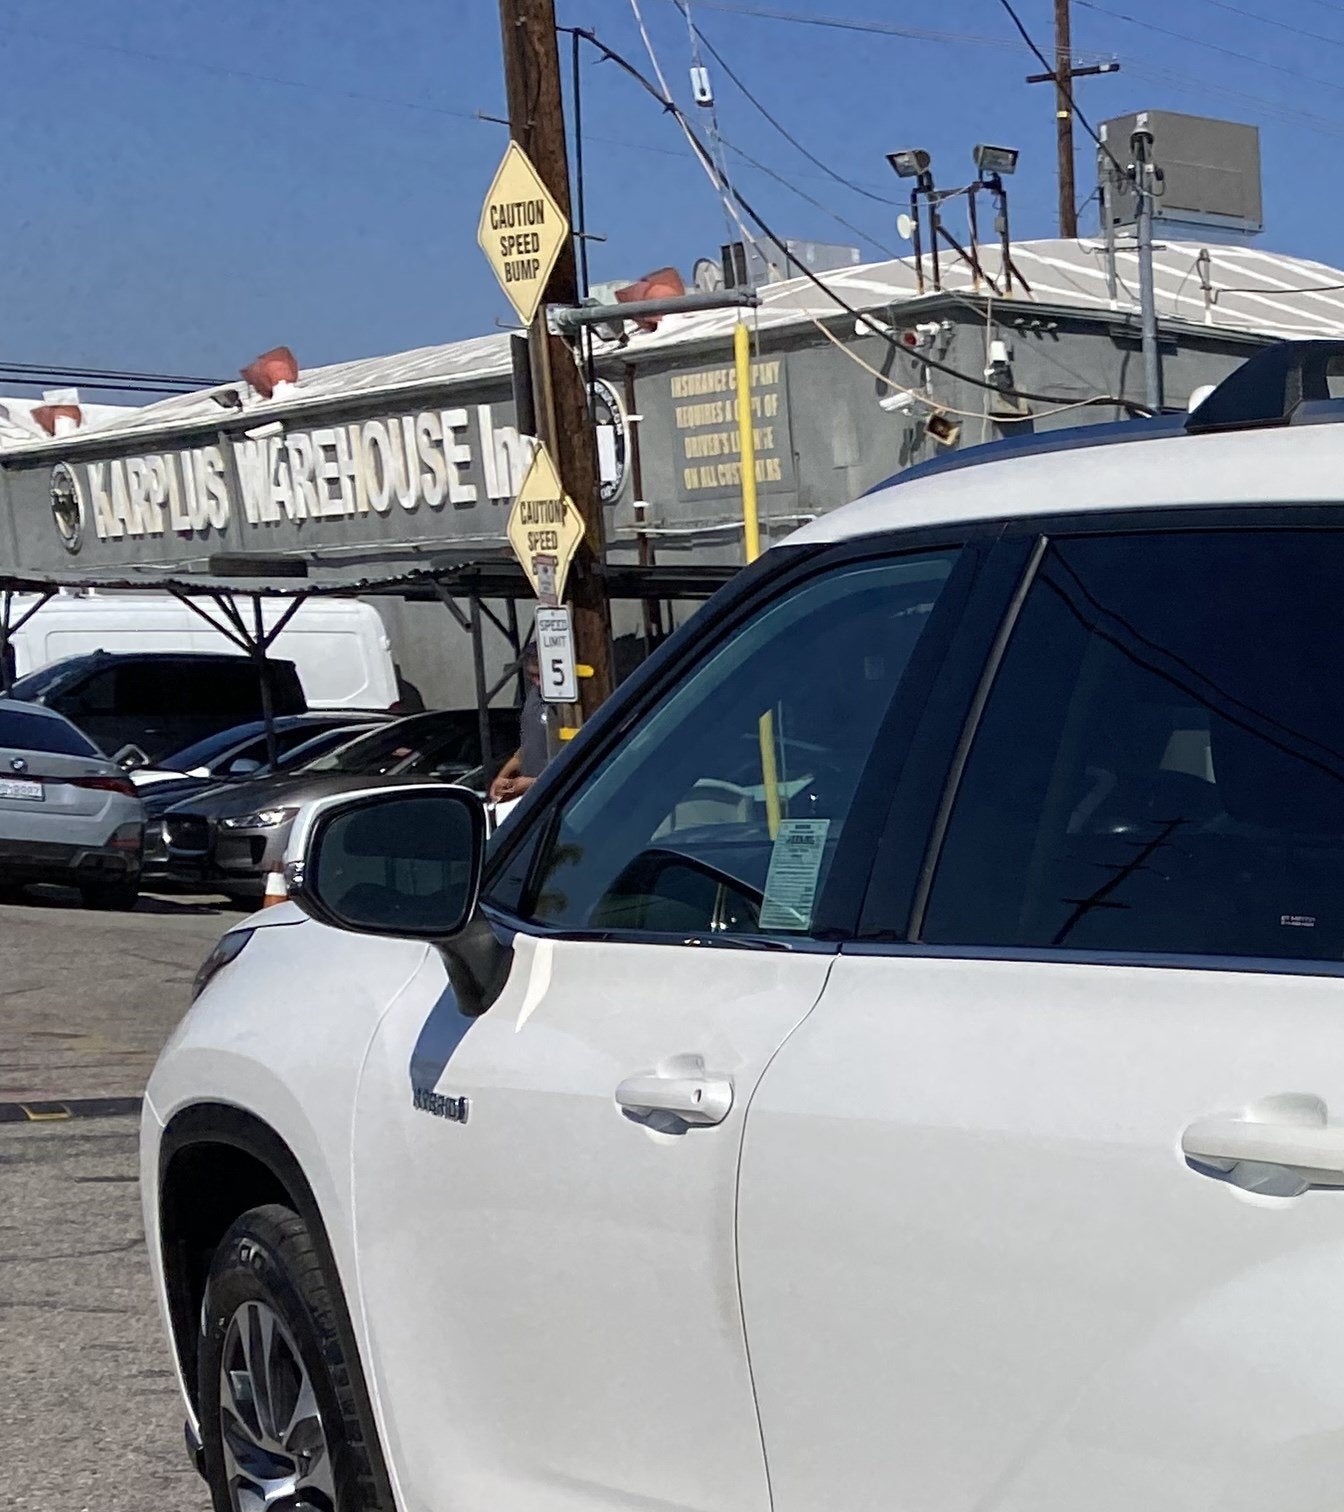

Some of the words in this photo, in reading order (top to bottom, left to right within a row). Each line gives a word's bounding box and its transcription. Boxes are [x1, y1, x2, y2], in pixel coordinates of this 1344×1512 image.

[489, 200, 545, 230] CAUTION
[500, 232, 540, 257] SPEED
[504, 258, 540, 283] BUMP
[728, 361, 780, 390] CPANY
[87, 446, 229, 538] KARPLUS
[233, 408, 477, 523] WAREHOUSE
[521, 499, 563, 525] CAUTION
[528, 530, 558, 552] SPEED
[540, 619, 568, 631] SPEED
[543, 636, 566, 648] LIMIT
[551, 658, 565, 686] 5
